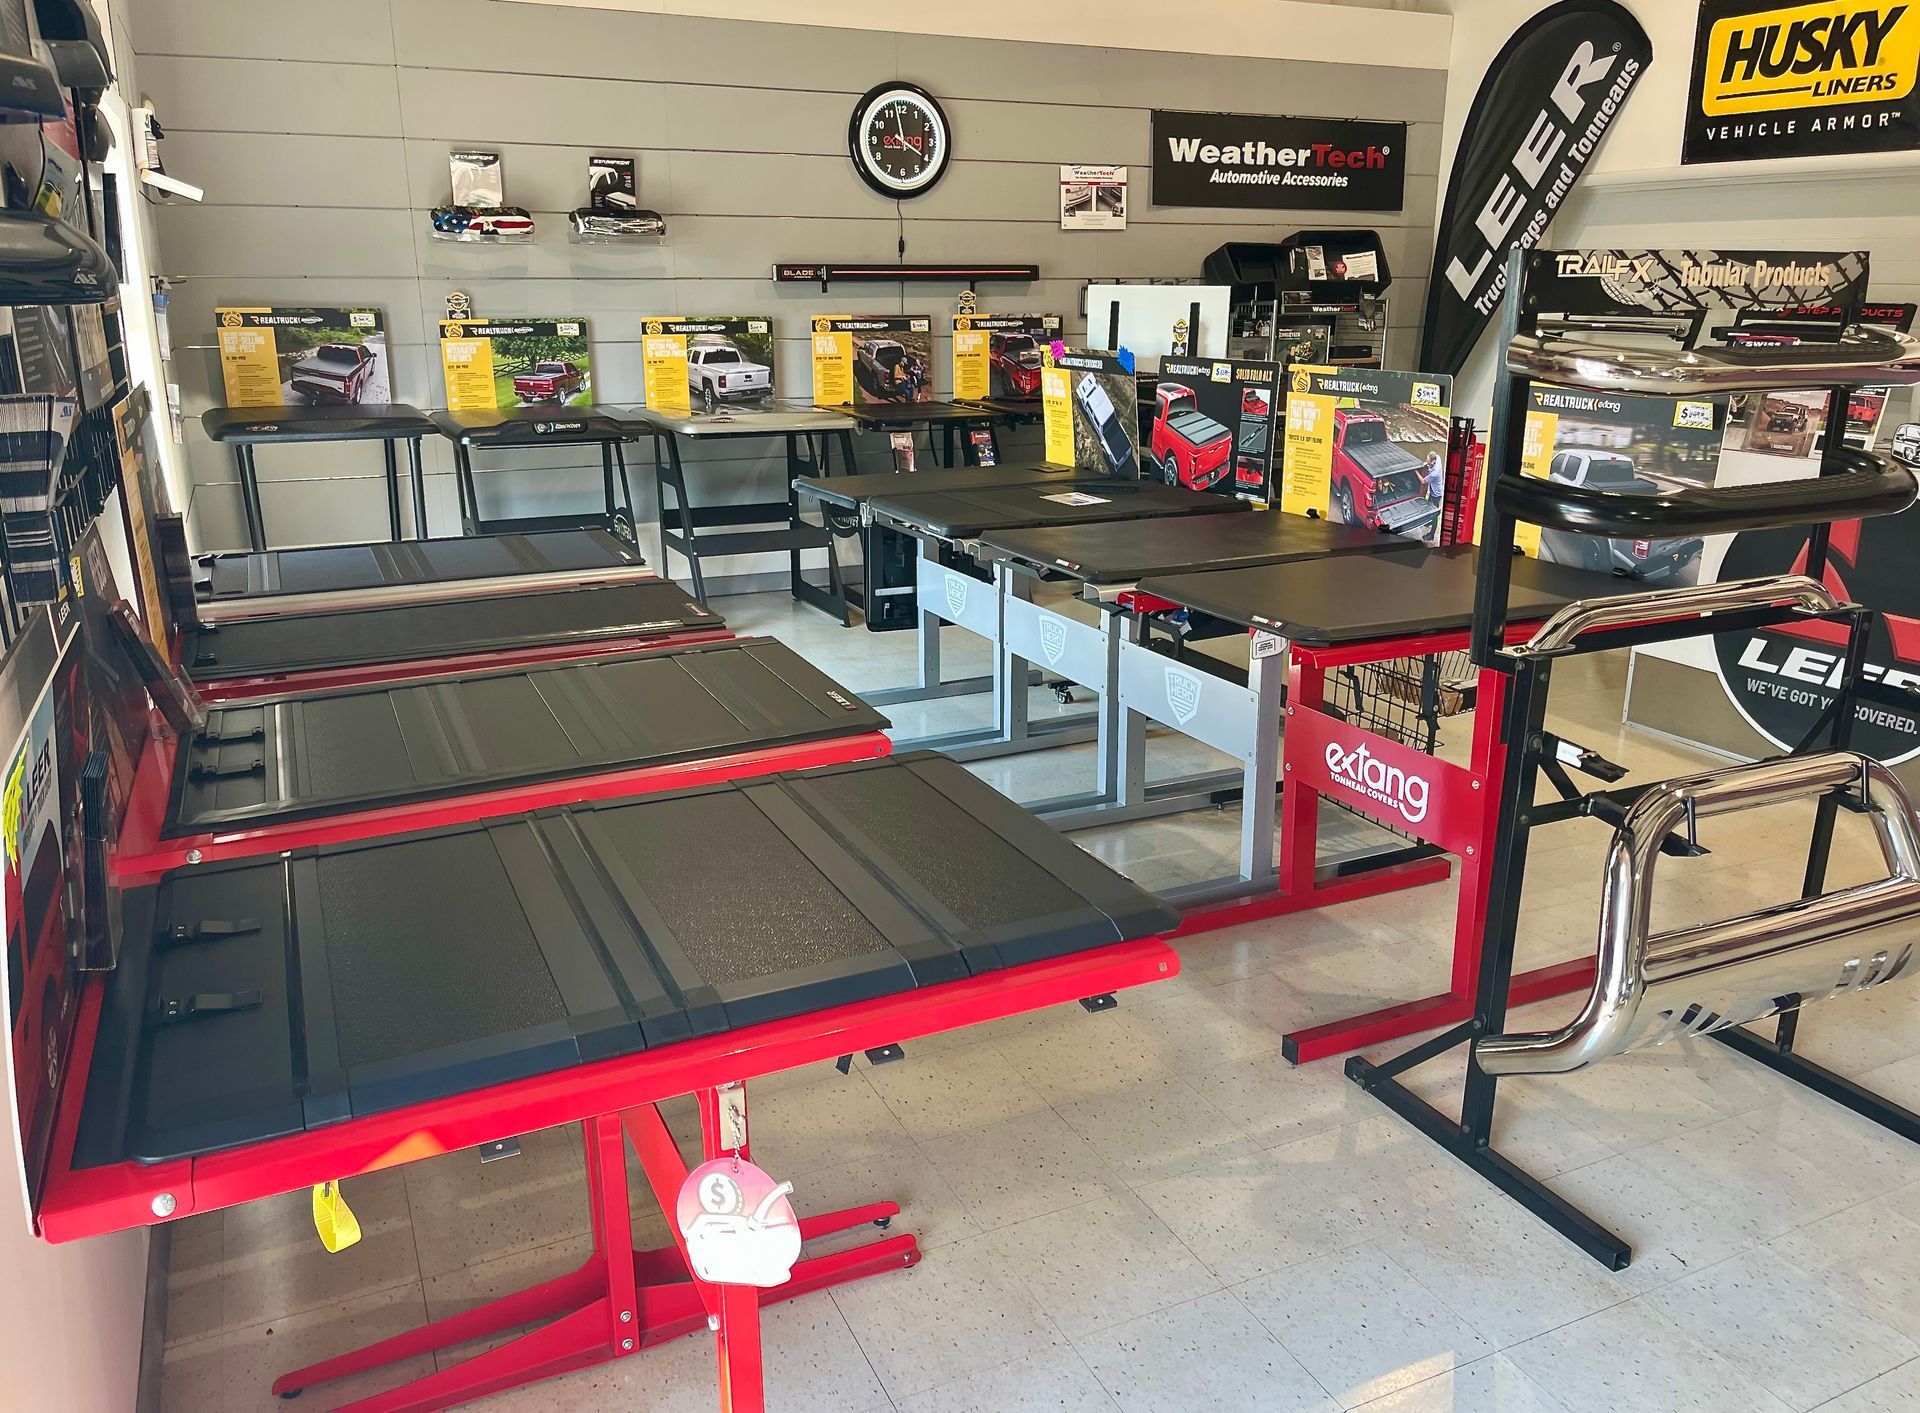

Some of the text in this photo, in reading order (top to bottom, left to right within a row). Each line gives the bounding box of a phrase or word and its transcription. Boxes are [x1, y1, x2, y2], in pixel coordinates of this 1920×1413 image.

[1720, 5, 1909, 84] HUSKY
[1811, 72, 1898, 98] LINERS
[885, 109, 894, 119] 11
[897, 105, 907, 114] 12
[913, 110, 918, 119] 1
[874, 120, 885, 130] 10
[924, 122, 930, 131] 2
[1706, 120, 1796, 141] VEHICLE
[871, 135, 878, 144] 9
[1545, 162, 1575, 209] and
[1567, 58, 1640, 164] Tonneaus
[883, 134, 922, 151] exng
[928, 138, 934, 147] 3
[593, 158, 631, 166] STAMPEDE
[875, 152, 881, 161] 8
[923, 153, 930, 162] 4
[886, 164, 892, 173] 7
[900, 168, 906, 177] 6
[914, 164, 919, 173] 5
[1209, 168, 1349, 188] Automotive Accessories
[1555, 254, 1831, 288] TRAILFX Tubular Products
[1796, 307, 1904, 318] STEP PDUCTS
[260, 316, 299, 325] REALTRUCK
[477, 327, 511, 335] REALTRUCK
[675, 324, 707, 332] REALTRUCK
[1171, 363, 1198, 376] REALTRUCK
[1324, 380, 1360, 393] REALTRUCK
[1543, 393, 1621, 413] REALTRUCK extang
[58, 601, 71, 627] LEER
[1042, 620, 1063, 637] TRUCK
[1044, 631, 1062, 645] HERO
[1169, 674, 1197, 694] TRUCK
[1170, 684, 1195, 703] HERO
[1747, 677, 1788, 700] WE'VE
[1789, 688, 1818, 708] GOT
[26, 737, 51, 816] LEER
[1325, 742, 1430, 824] extang
[1329, 771, 1399, 809] TONNEAU COVERS
